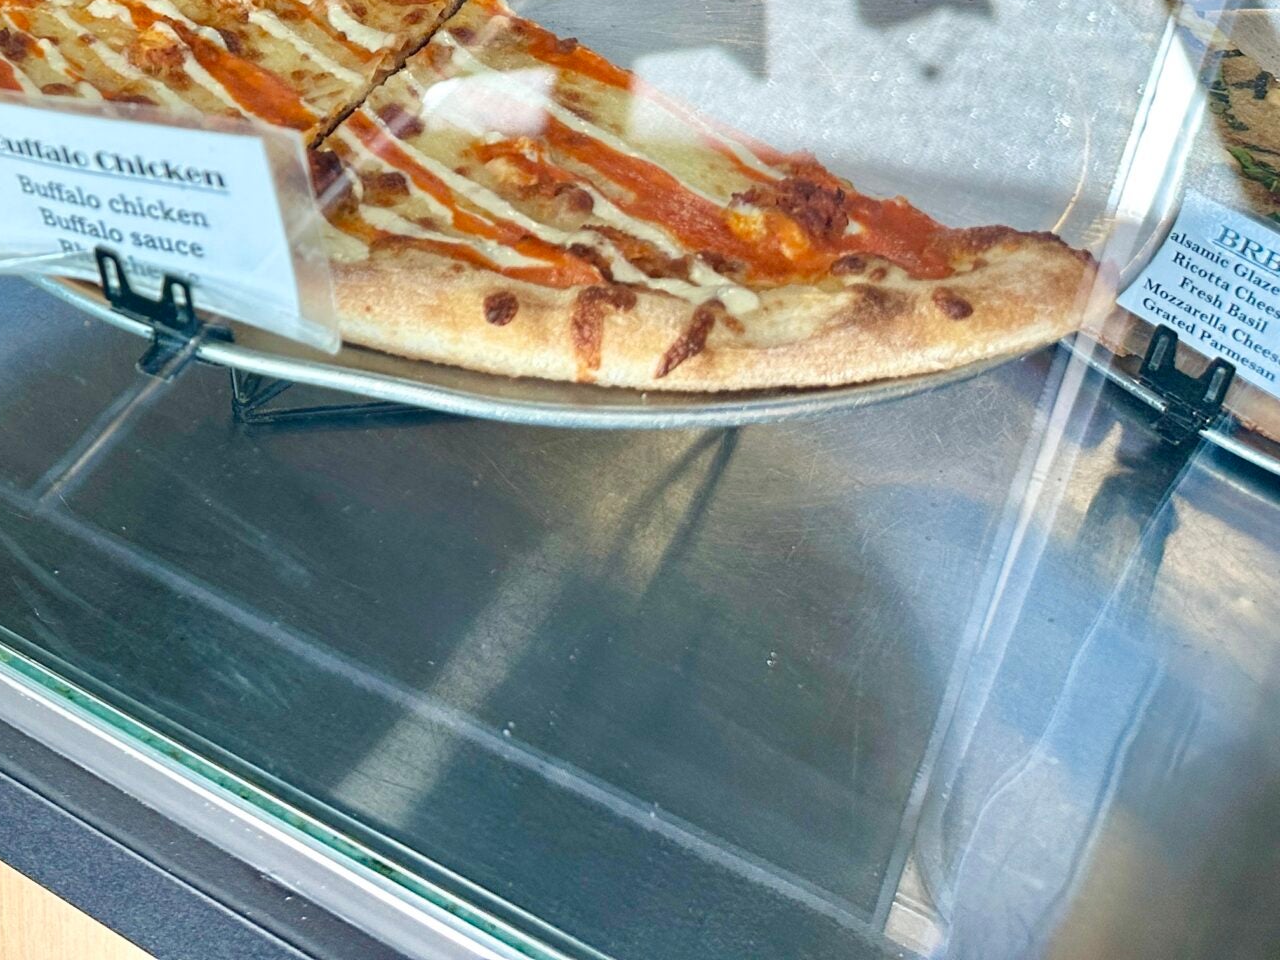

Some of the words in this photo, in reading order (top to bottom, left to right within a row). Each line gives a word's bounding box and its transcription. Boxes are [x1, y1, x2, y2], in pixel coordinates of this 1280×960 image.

[94, 148, 227, 188] Chicken
[16, 173, 101, 210] Buffalo
[107, 191, 211, 229] chicken
[38, 205, 122, 242] Buffalo
[129, 230, 205, 258] sauce
[1171, 250, 1231, 292] Ricotta
[1233, 262, 1280, 296] Glaze
[1142, 277, 1228, 334] Mozzarella
[1178, 276, 1224, 310] Fresh
[1226, 302, 1269, 334] Basil
[1142, 297, 1197, 336] Grated
[1198, 328, 1277, 383] Parmesan
